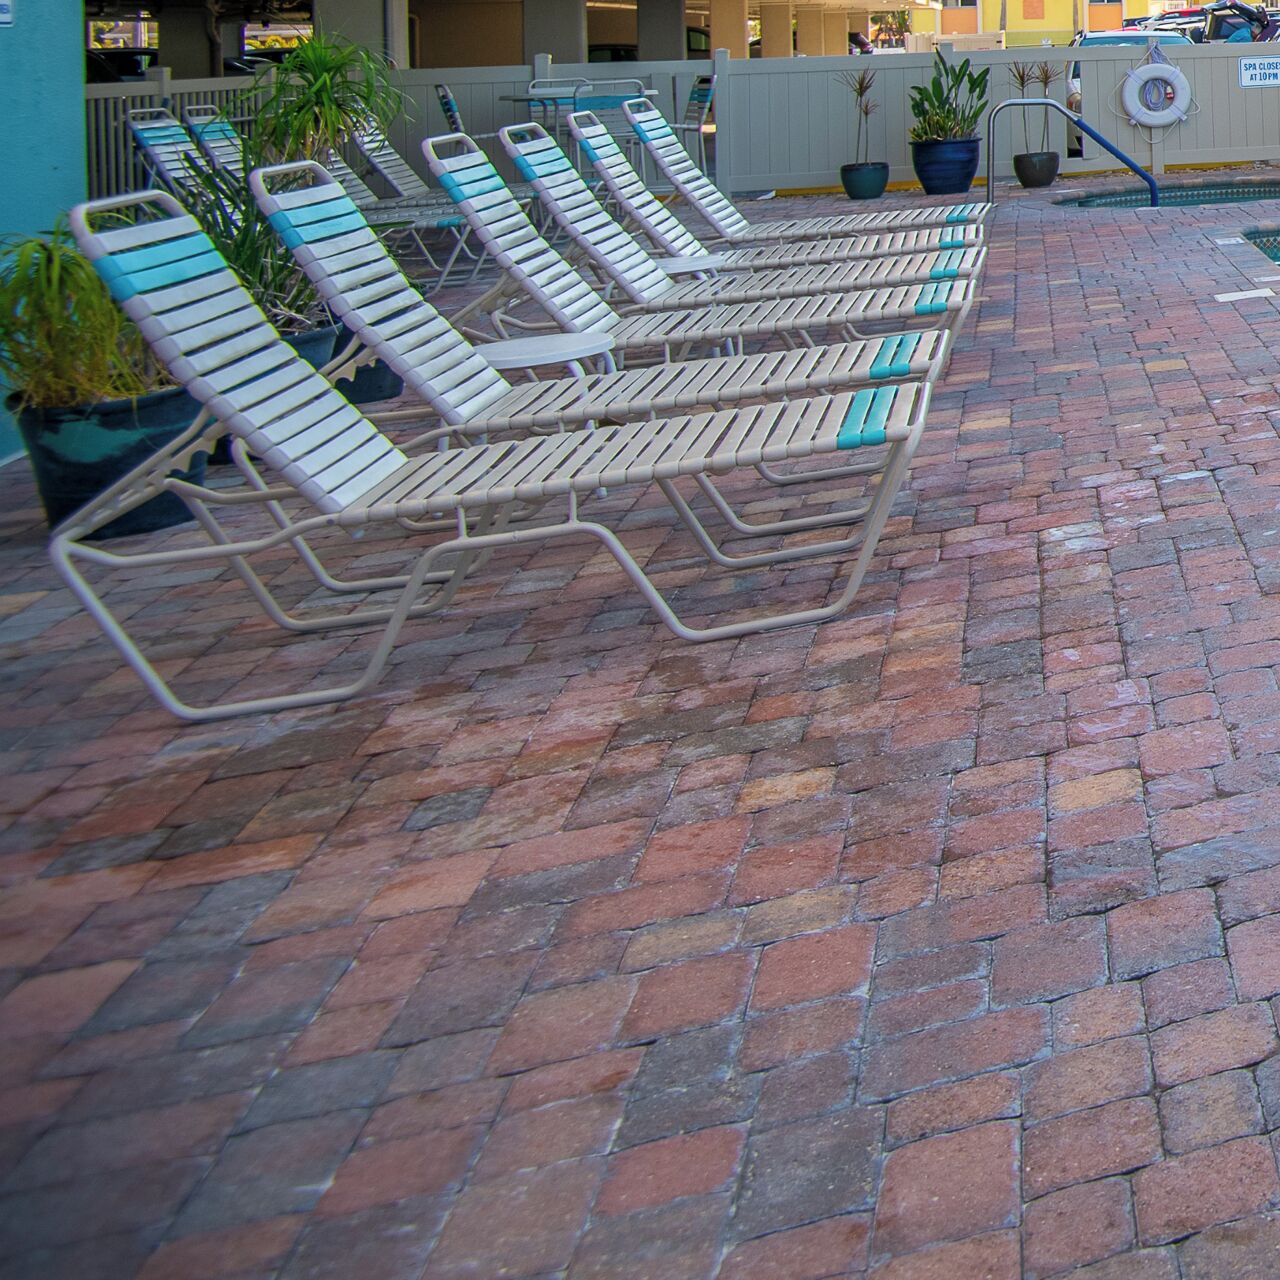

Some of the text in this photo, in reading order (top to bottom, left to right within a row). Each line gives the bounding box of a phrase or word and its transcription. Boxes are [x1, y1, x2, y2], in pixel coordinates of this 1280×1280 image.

[1243, 63, 1257, 71] SPA
[1250, 73, 1257, 81] AT
[1259, 72, 1267, 81] 10
